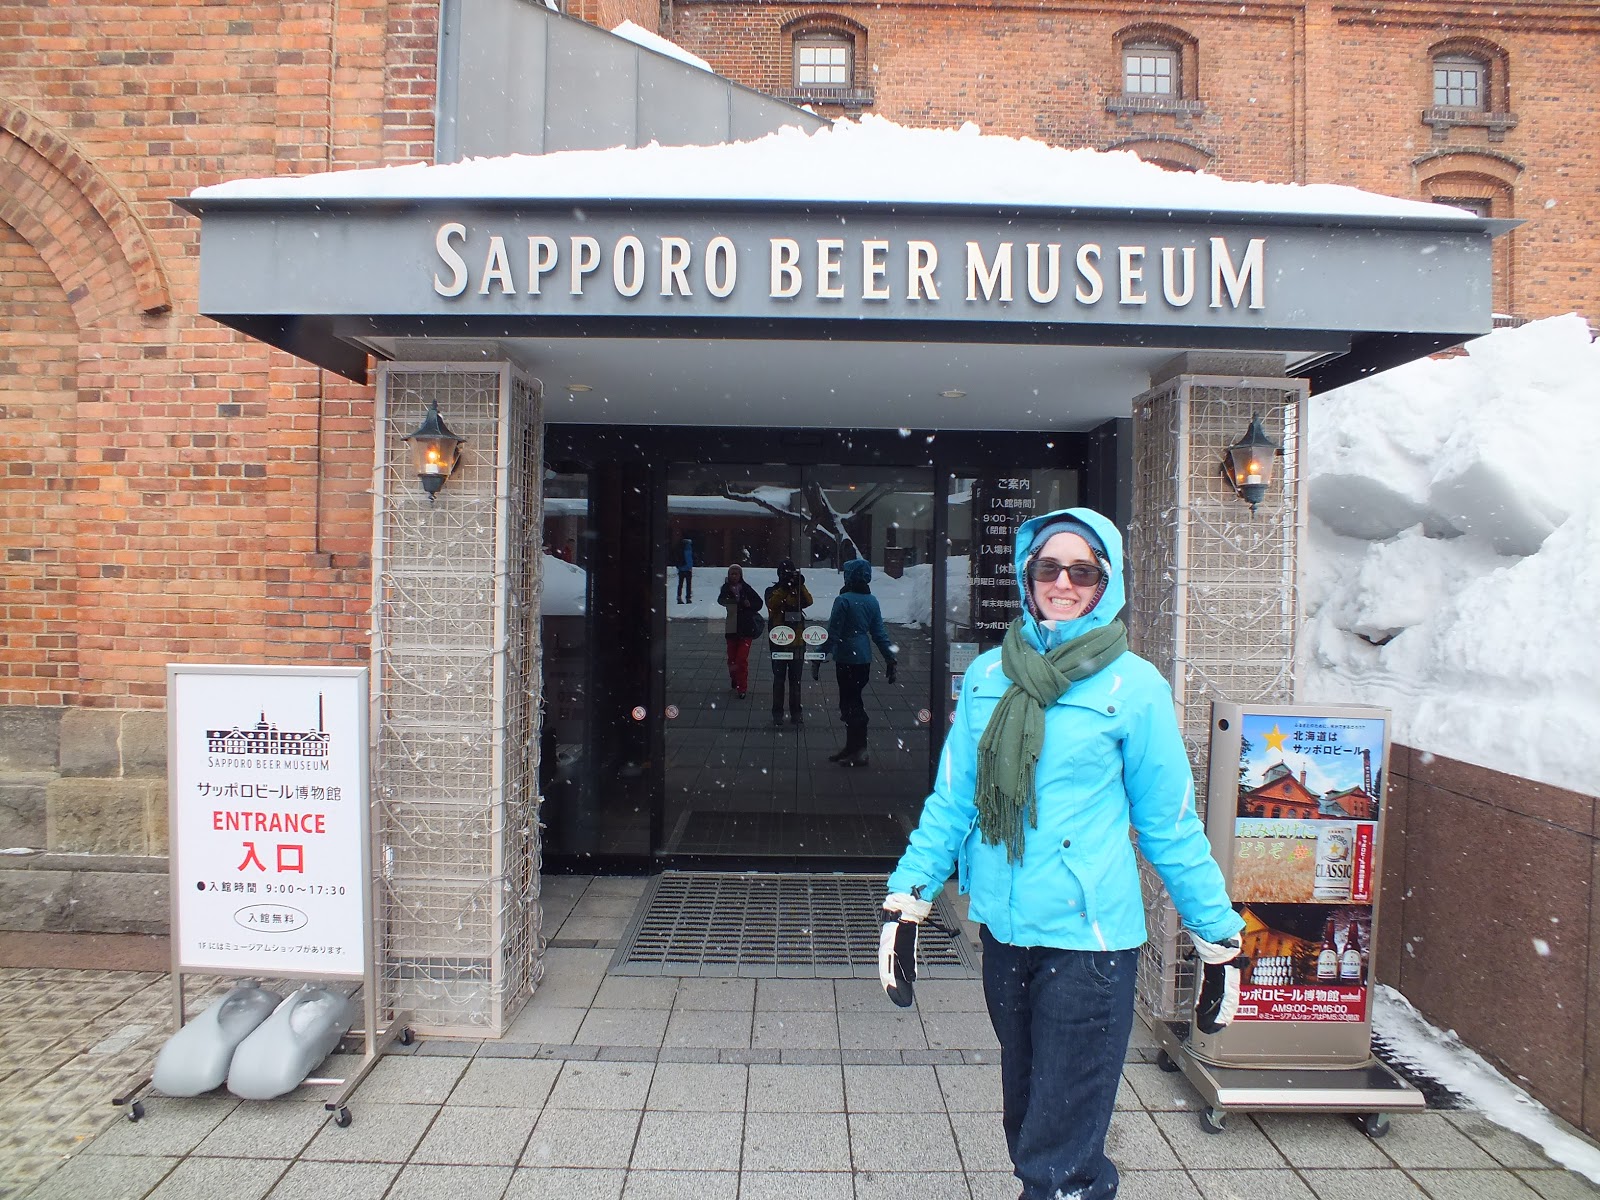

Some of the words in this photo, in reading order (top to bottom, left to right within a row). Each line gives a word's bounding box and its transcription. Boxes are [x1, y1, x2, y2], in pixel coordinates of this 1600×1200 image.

[433, 222, 738, 299] SAPPORO
[769, 237, 940, 302] BEER
[965, 237, 1266, 310] MUSEUM
[998, 478, 1030, 490] ご案内
[1293, 730, 1338, 742] 北海道は
[1292, 744, 1363, 756] サッポロビール
[208, 756, 252, 769] SAPPORO
[256, 759, 281, 770] BEER
[284, 759, 330, 771] MUSEUM
[197, 782, 342, 801] サッポロビール博物館
[213, 810, 326, 834] ENTRANCE
[1238, 822, 1318, 839] おみやげに
[237, 841, 304, 874] 入口
[1238, 840, 1286, 860] どうぞ
[1315, 863, 1352, 878] CLASSIC
[209, 881, 257, 894] 入館時間
[248, 913, 295, 924] 入館無料
[1239, 988, 1340, 1002] ッポロビール博物館
